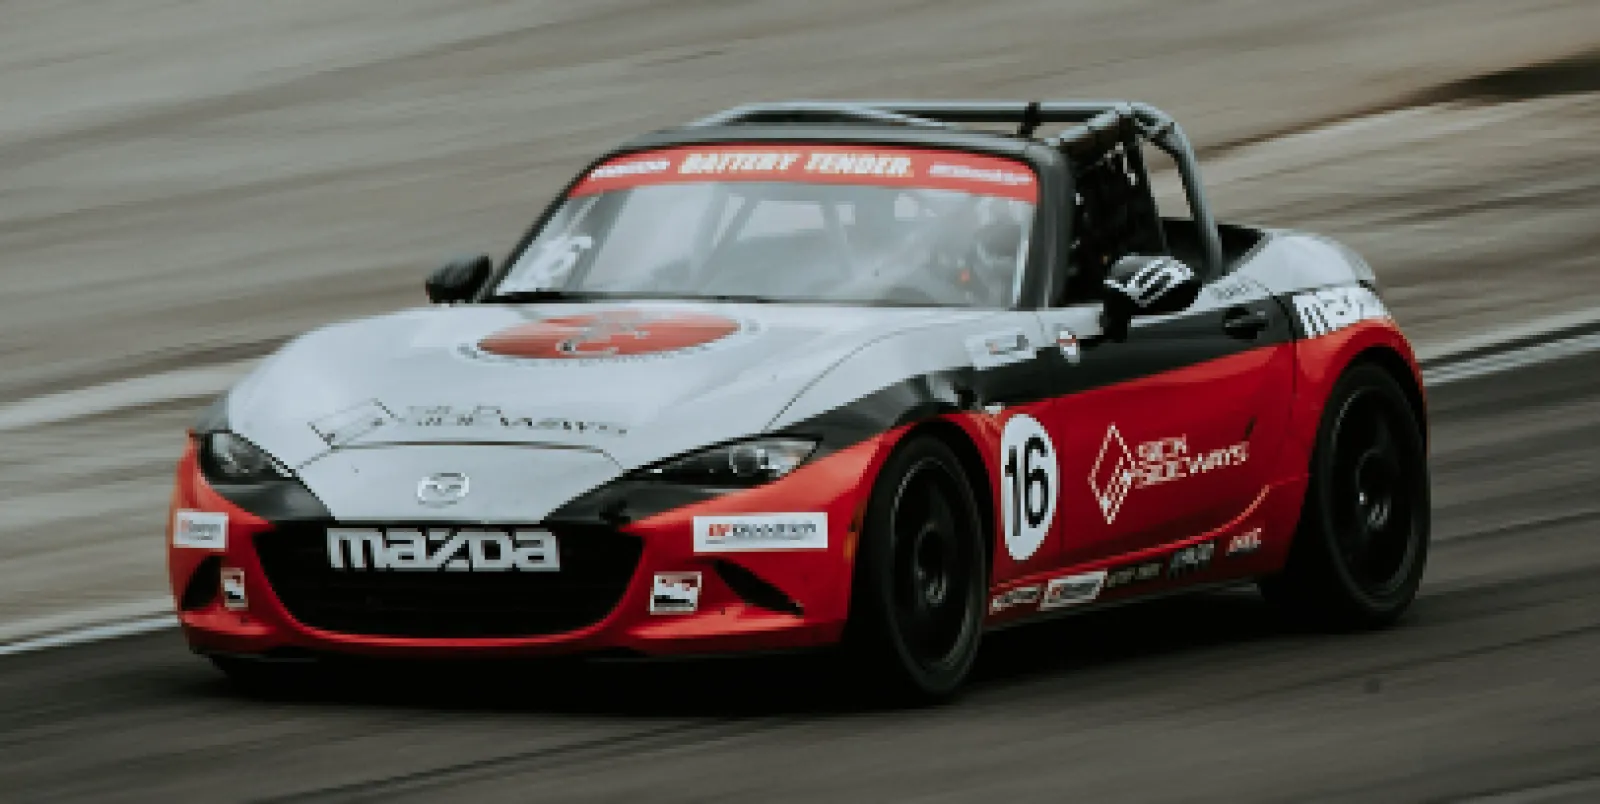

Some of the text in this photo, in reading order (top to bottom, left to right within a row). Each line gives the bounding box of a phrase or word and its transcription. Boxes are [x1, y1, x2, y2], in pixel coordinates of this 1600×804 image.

[678, 152, 799, 175] BATTERY
[1004, 433, 1050, 538] 16
[1133, 441, 1250, 489] SIDEWAYS
